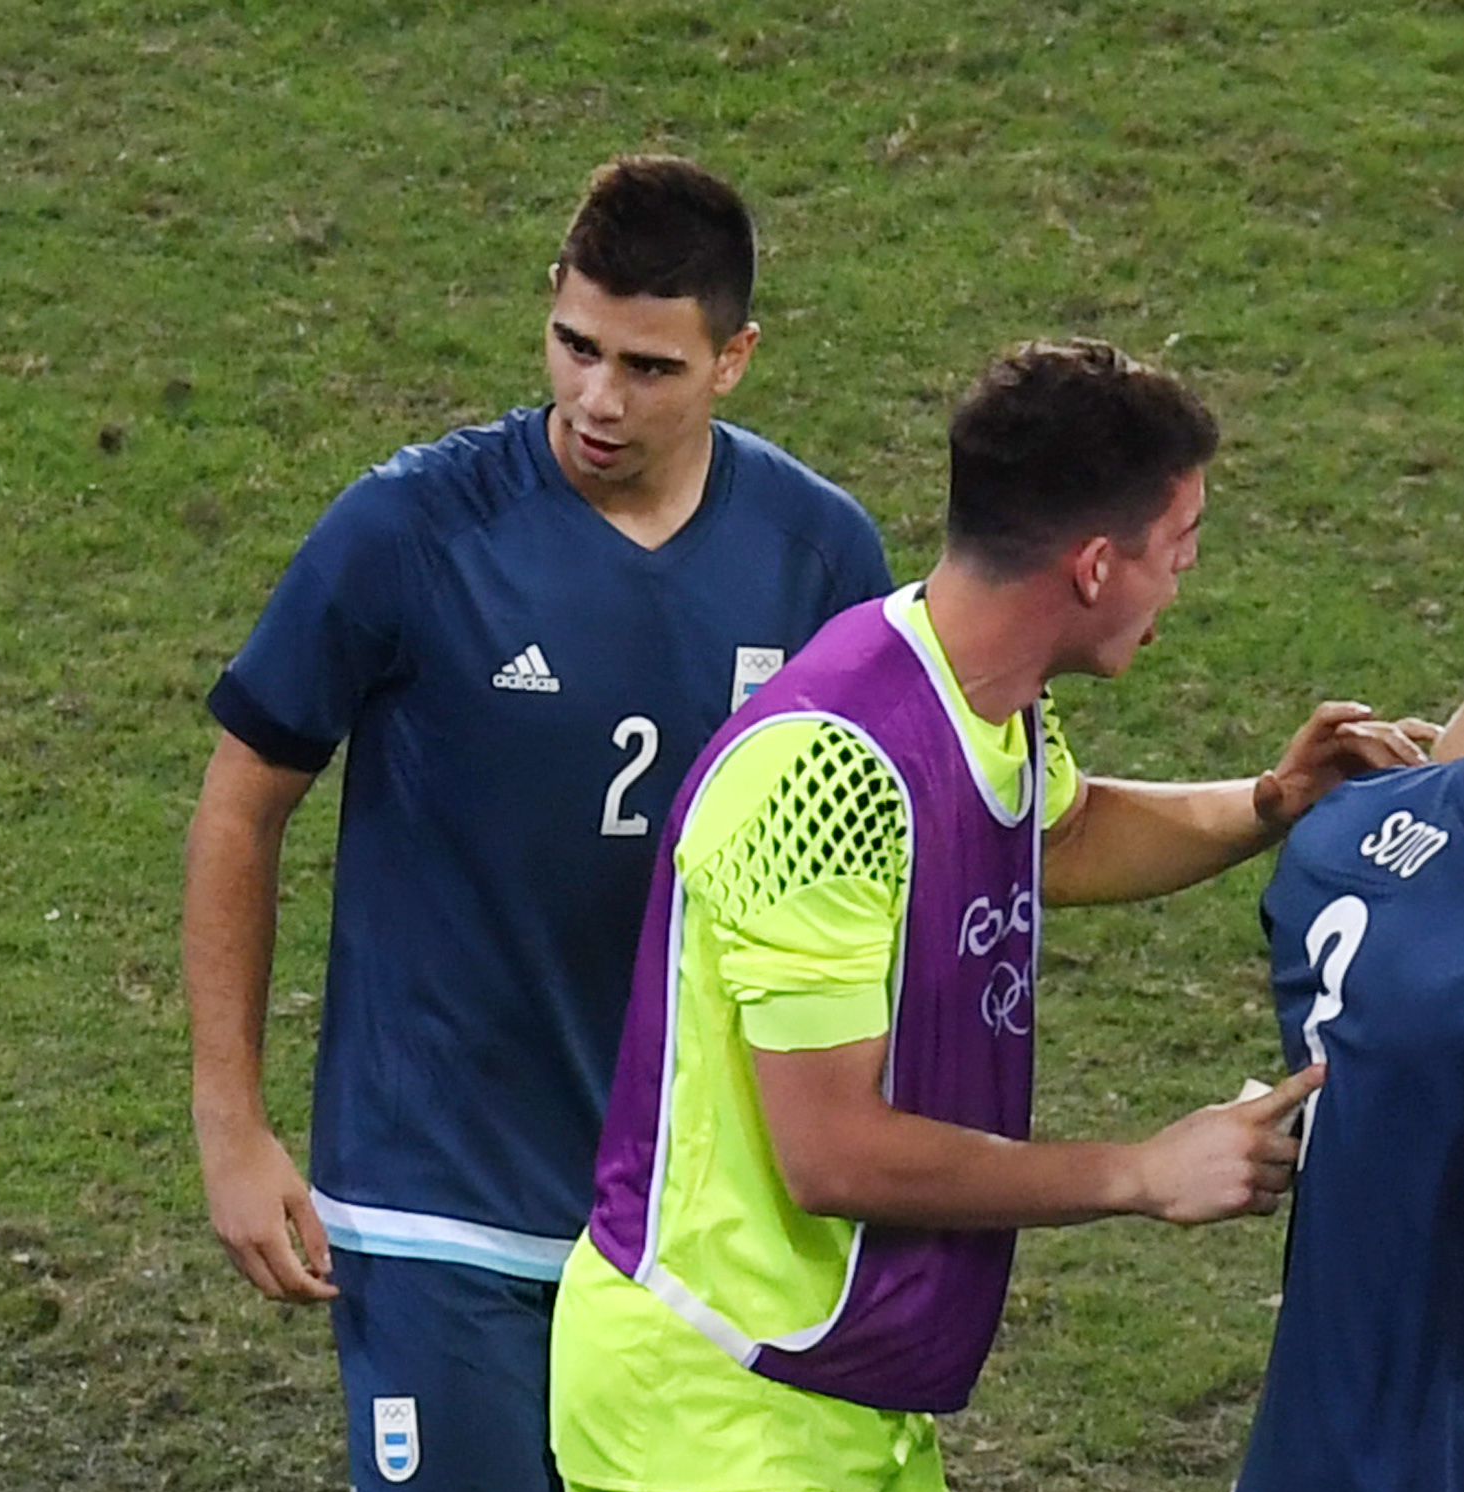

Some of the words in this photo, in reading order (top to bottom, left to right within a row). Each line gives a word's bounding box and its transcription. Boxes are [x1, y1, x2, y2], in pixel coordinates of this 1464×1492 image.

[492, 672, 561, 693] adidas
[600, 715, 659, 836] 2
[1360, 809, 1449, 879] SOTO
